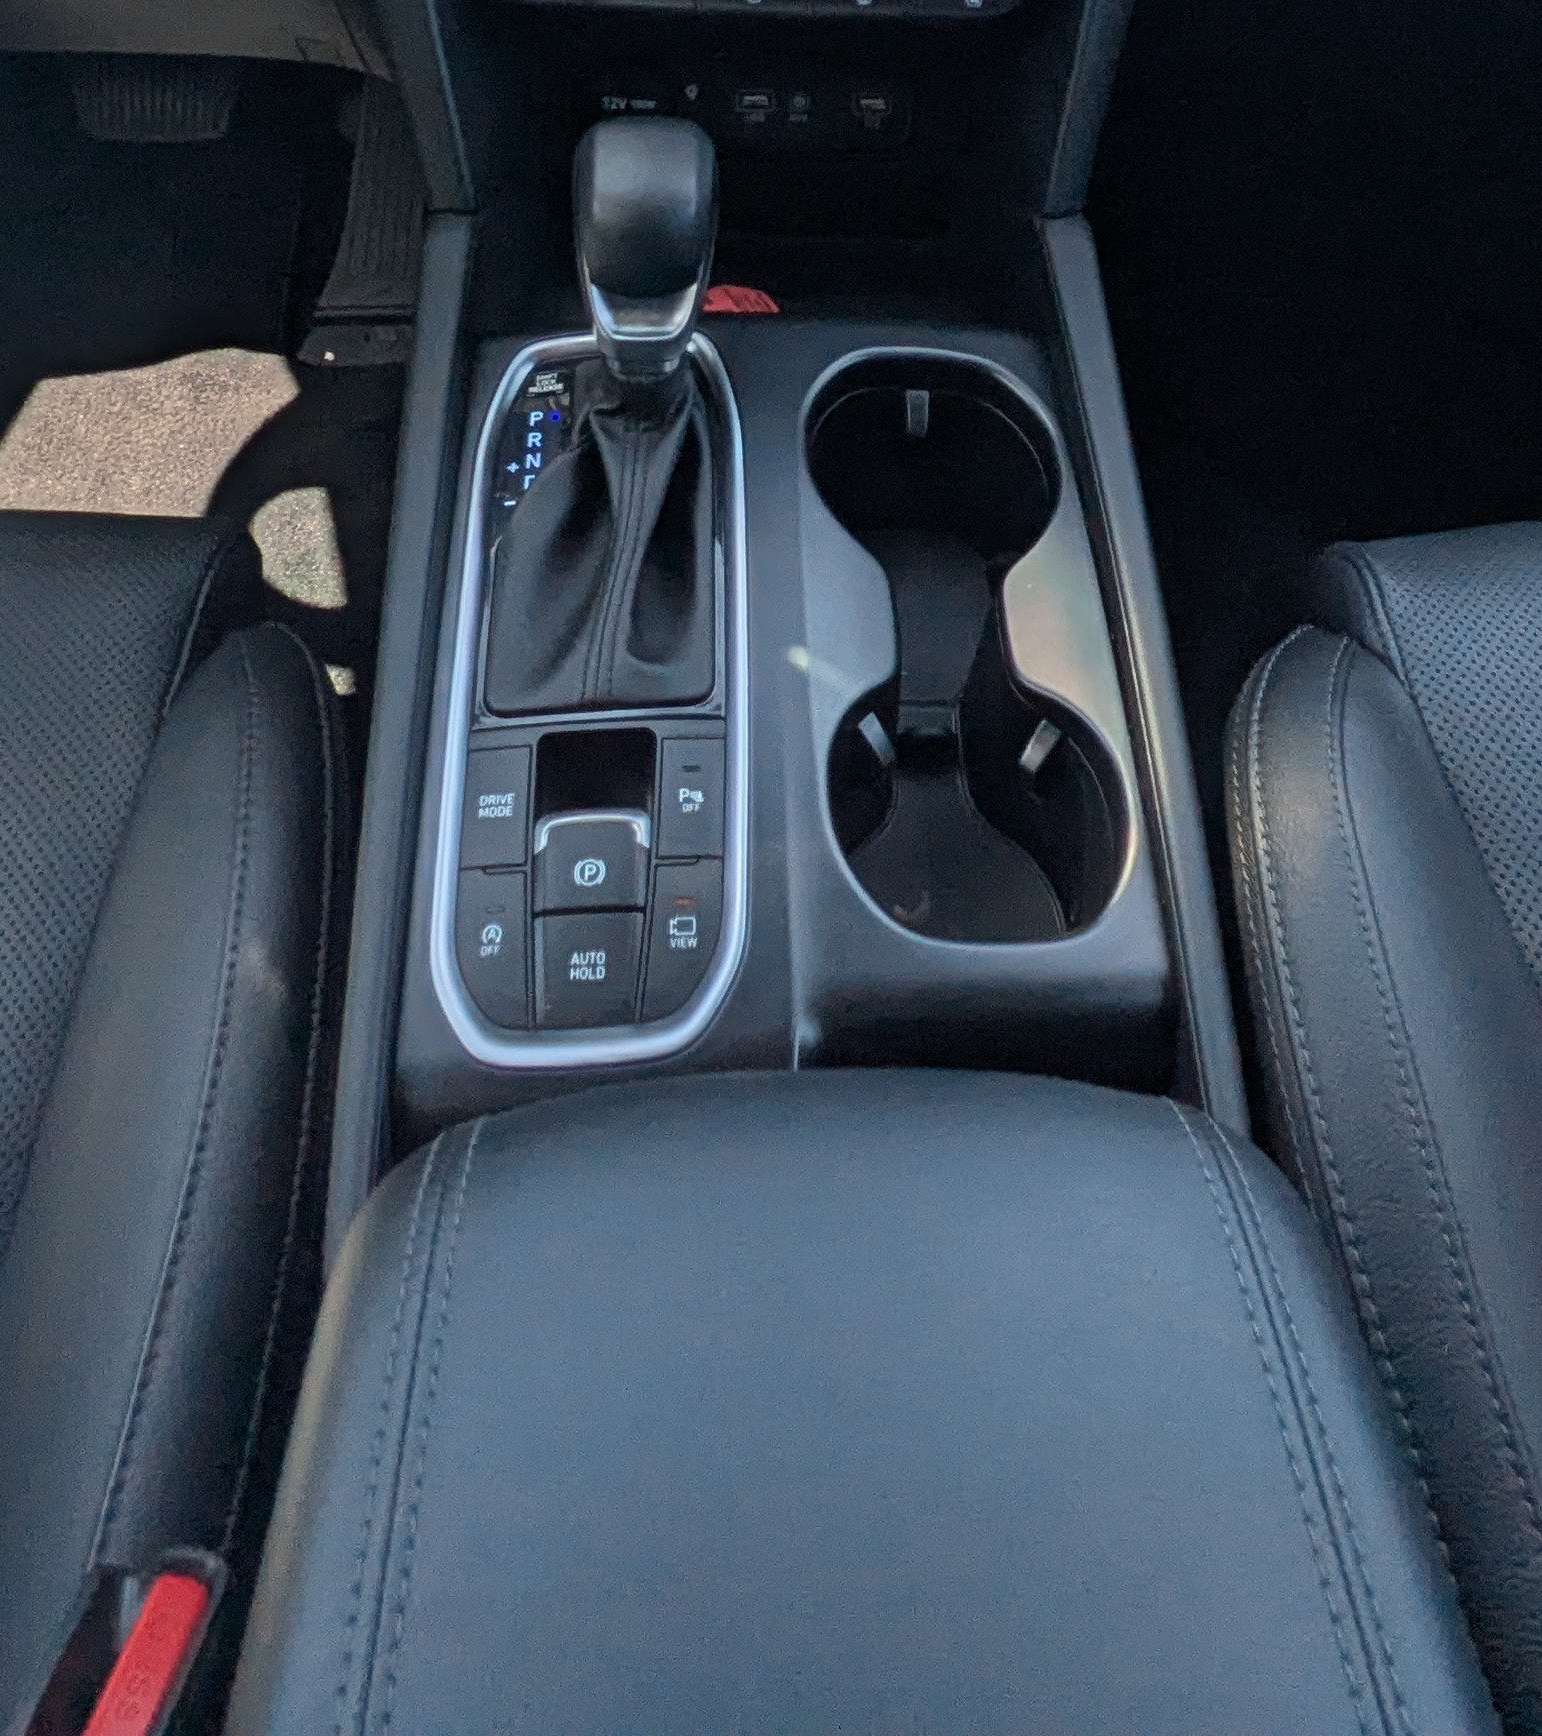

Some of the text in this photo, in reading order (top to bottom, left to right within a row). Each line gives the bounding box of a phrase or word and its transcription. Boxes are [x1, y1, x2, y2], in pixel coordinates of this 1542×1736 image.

[529, 412, 543, 426] P
[526, 432, 542, 448] R
[525, 453, 541, 469] N
[478, 793, 515, 807] DRIVE
[478, 806, 513, 819] MODE
[682, 804, 700, 813] OFF
[670, 937, 698, 948] VIEW
[480, 945, 500, 957] OFF
[571, 952, 606, 965] AUTO
[570, 967, 605, 981] HOLD
